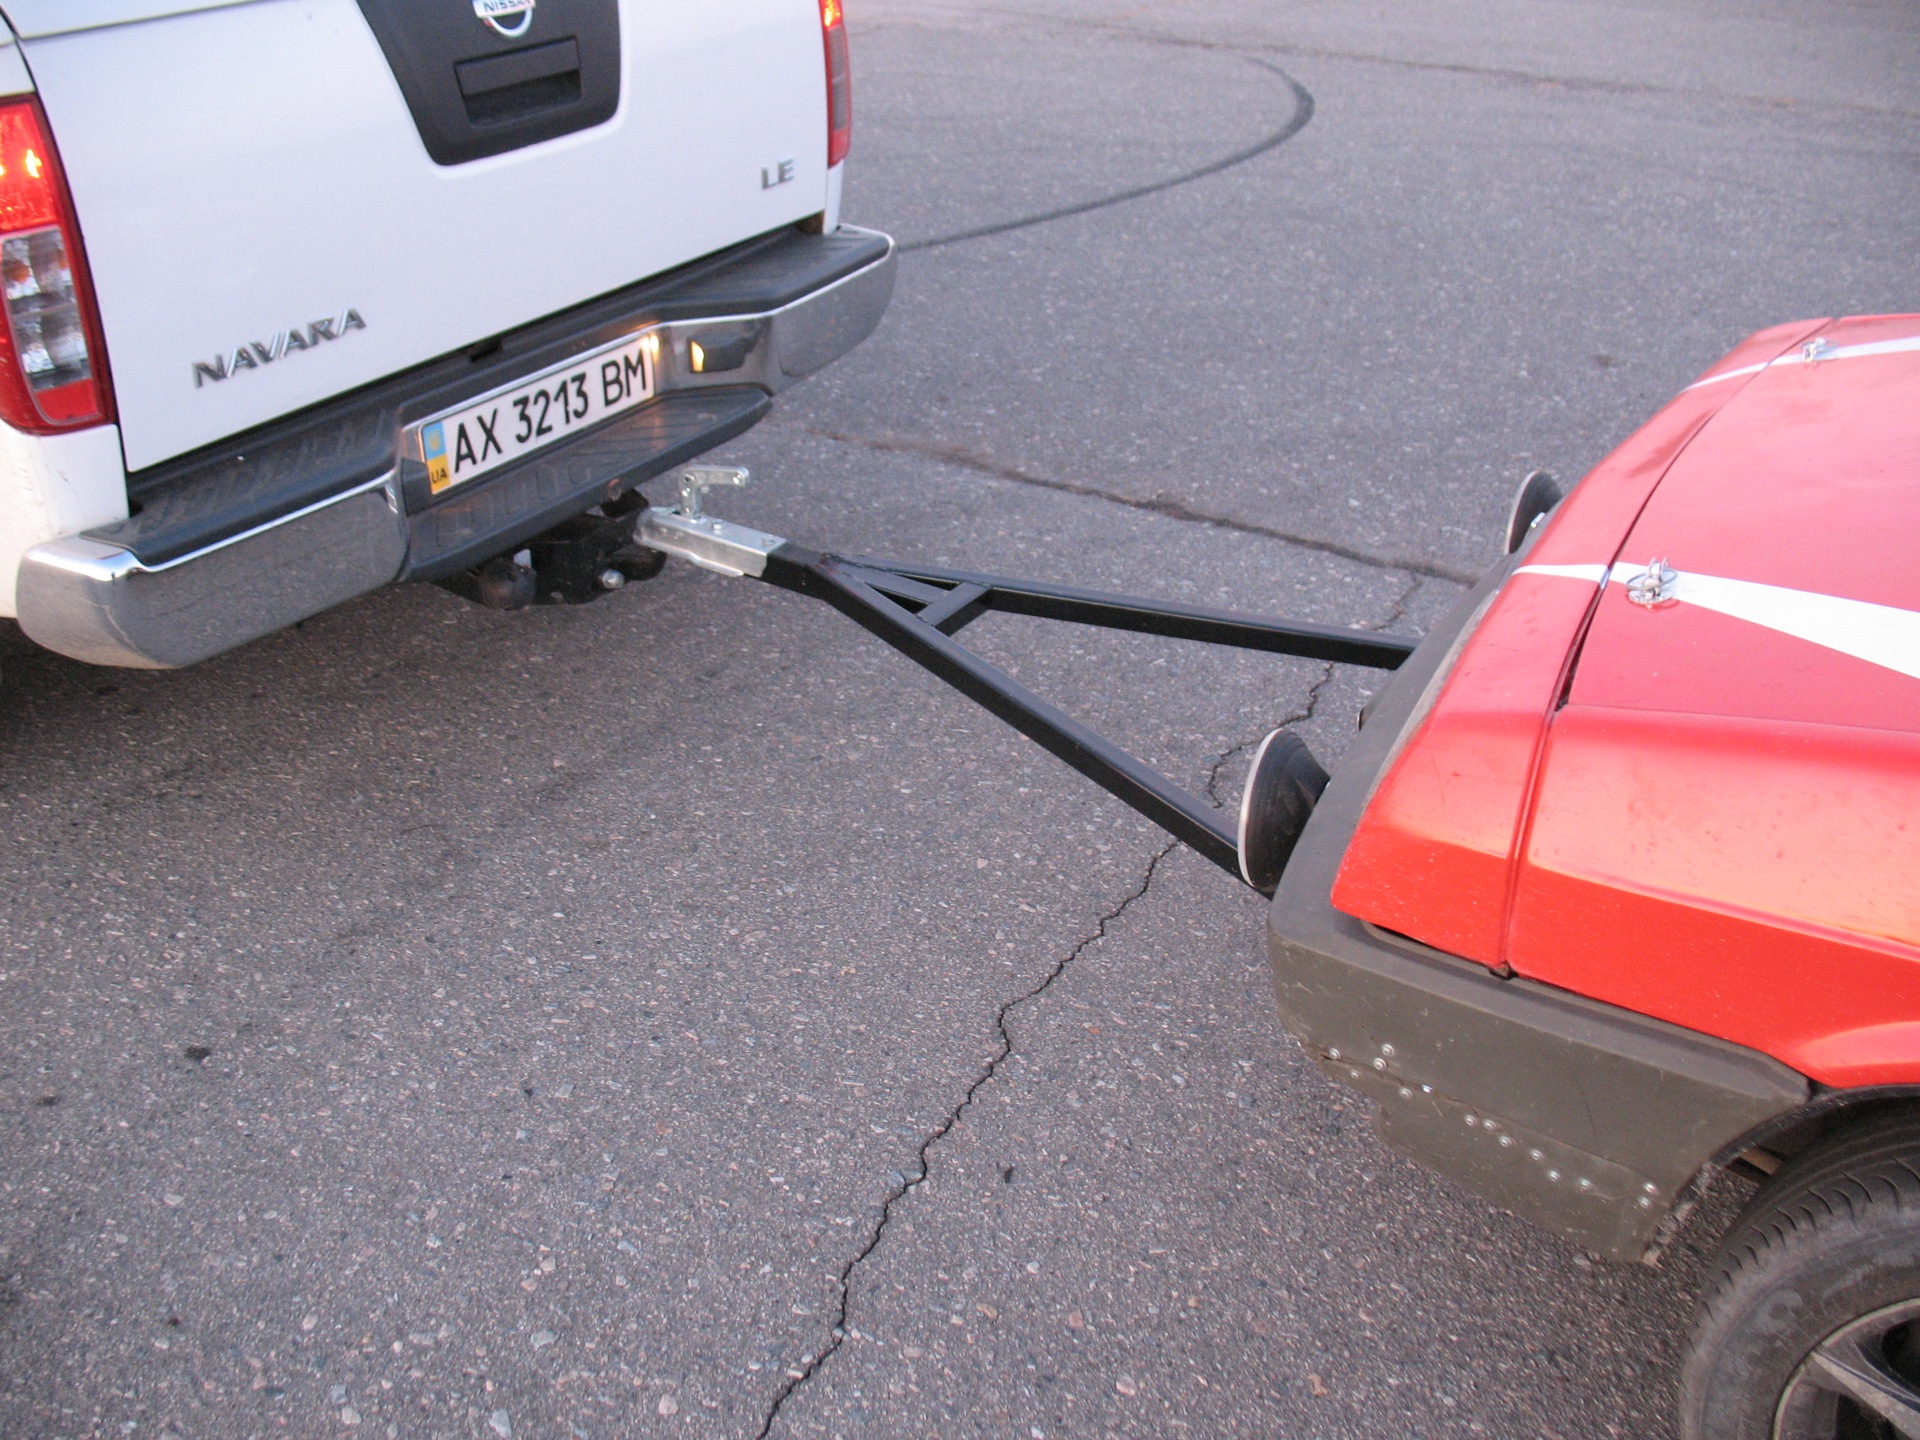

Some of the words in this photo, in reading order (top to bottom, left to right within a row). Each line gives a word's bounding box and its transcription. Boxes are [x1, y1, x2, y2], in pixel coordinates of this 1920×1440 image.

[483, 0, 531, 12] NISS
[761, 158, 795, 190] LE
[192, 308, 367, 389] NAVARA
[454, 408, 503, 474] AX
[512, 372, 589, 443] 3213
[601, 346, 647, 407] BM
[431, 467, 448, 484] UA
